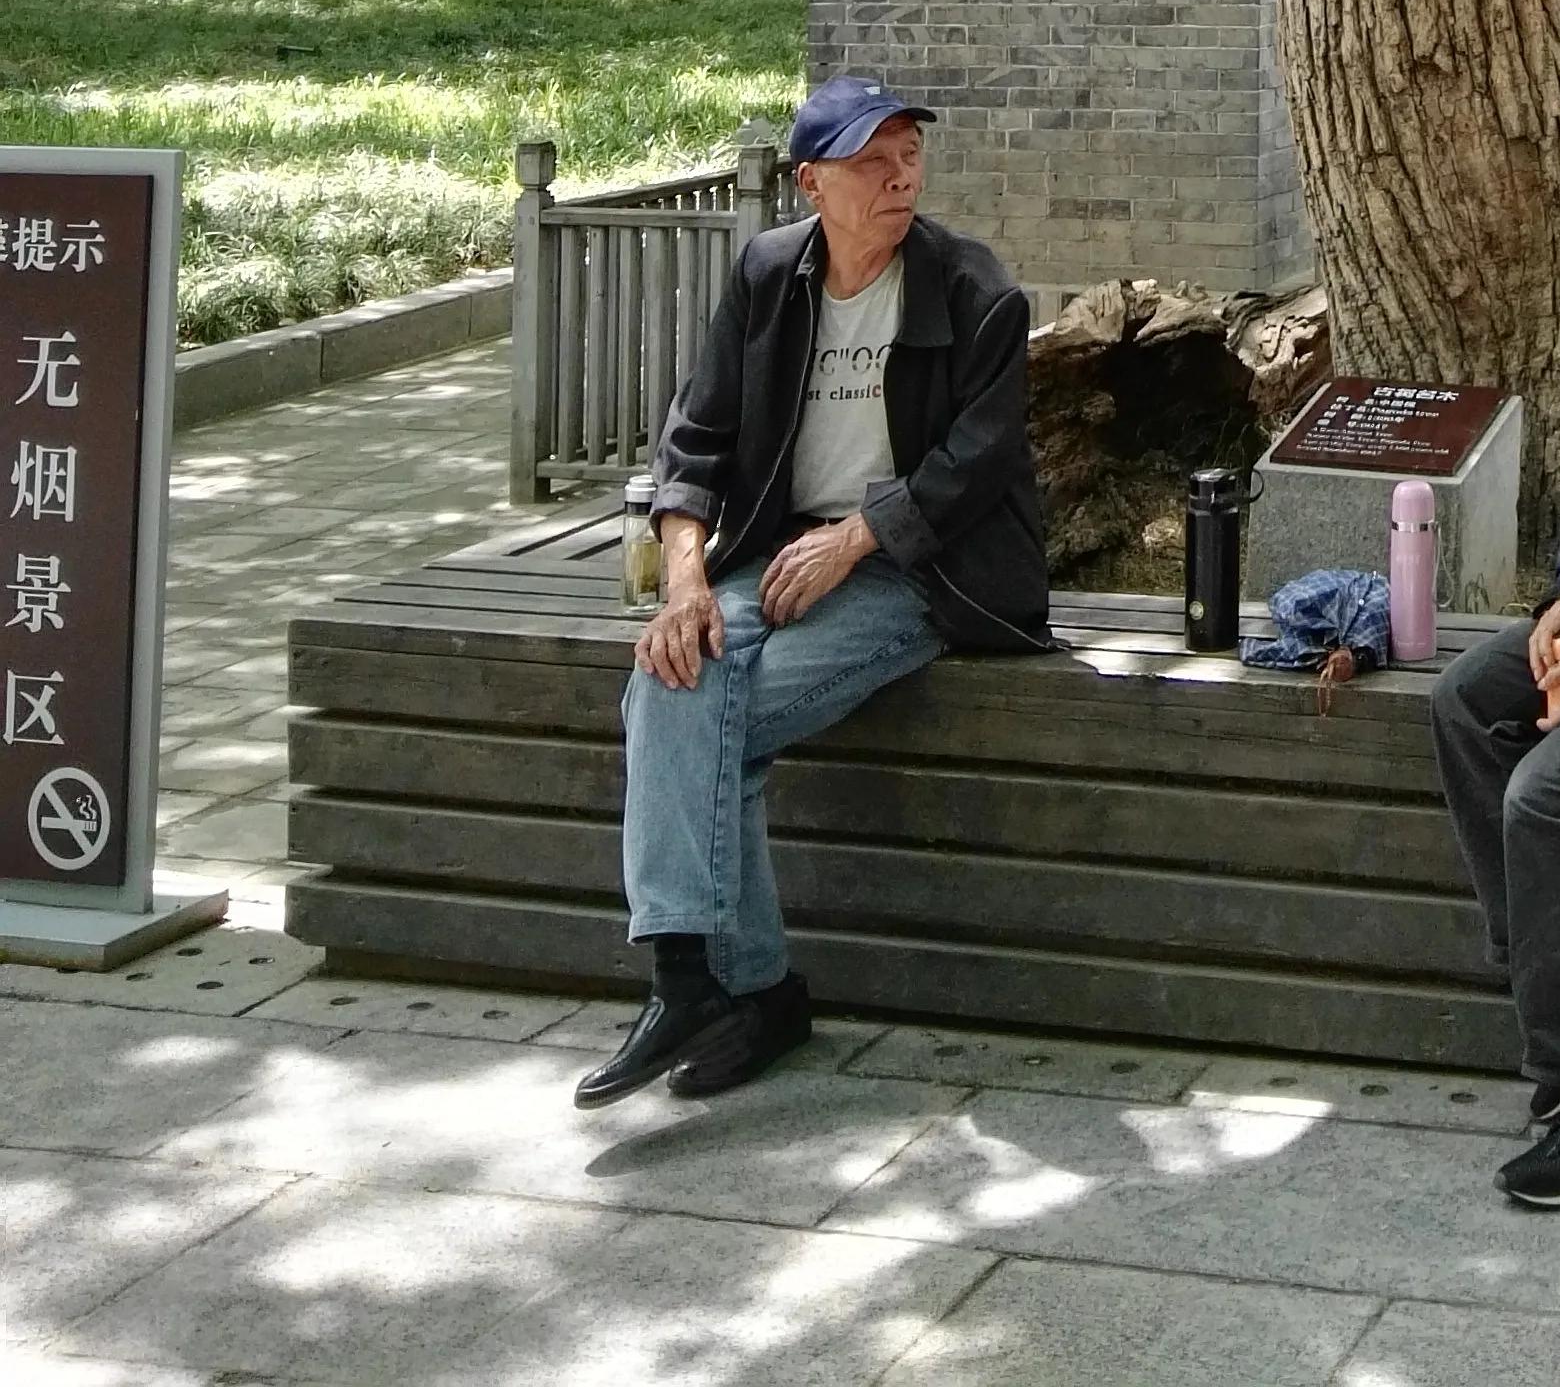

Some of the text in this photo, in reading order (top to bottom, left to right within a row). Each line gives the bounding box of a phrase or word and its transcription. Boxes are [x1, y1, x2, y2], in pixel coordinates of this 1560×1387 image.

[0, 216, 106, 273] 提示
[829, 383, 882, 401] classic
[3, 329, 82, 748] 无烟景区
